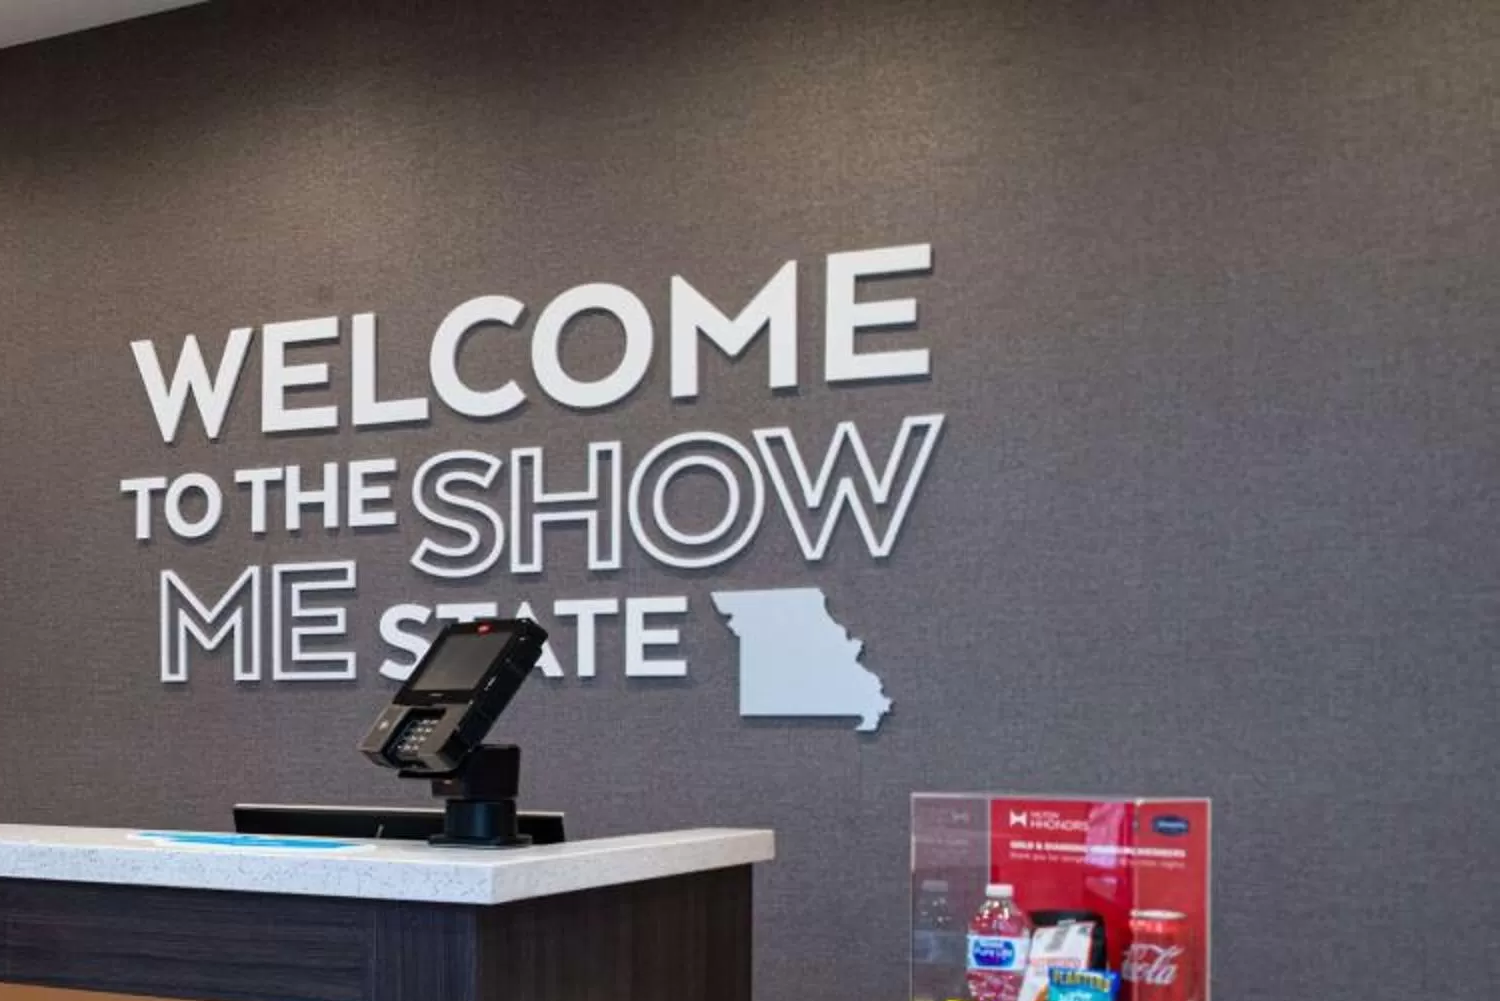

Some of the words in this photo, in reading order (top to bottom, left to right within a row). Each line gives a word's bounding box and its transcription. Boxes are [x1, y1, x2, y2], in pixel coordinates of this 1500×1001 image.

[131, 243, 933, 443] WELCOME
[121, 472, 223, 541] TO
[235, 458, 398, 533] THE
[411, 413, 945, 578] SHOW
[159, 560, 358, 682] ME
